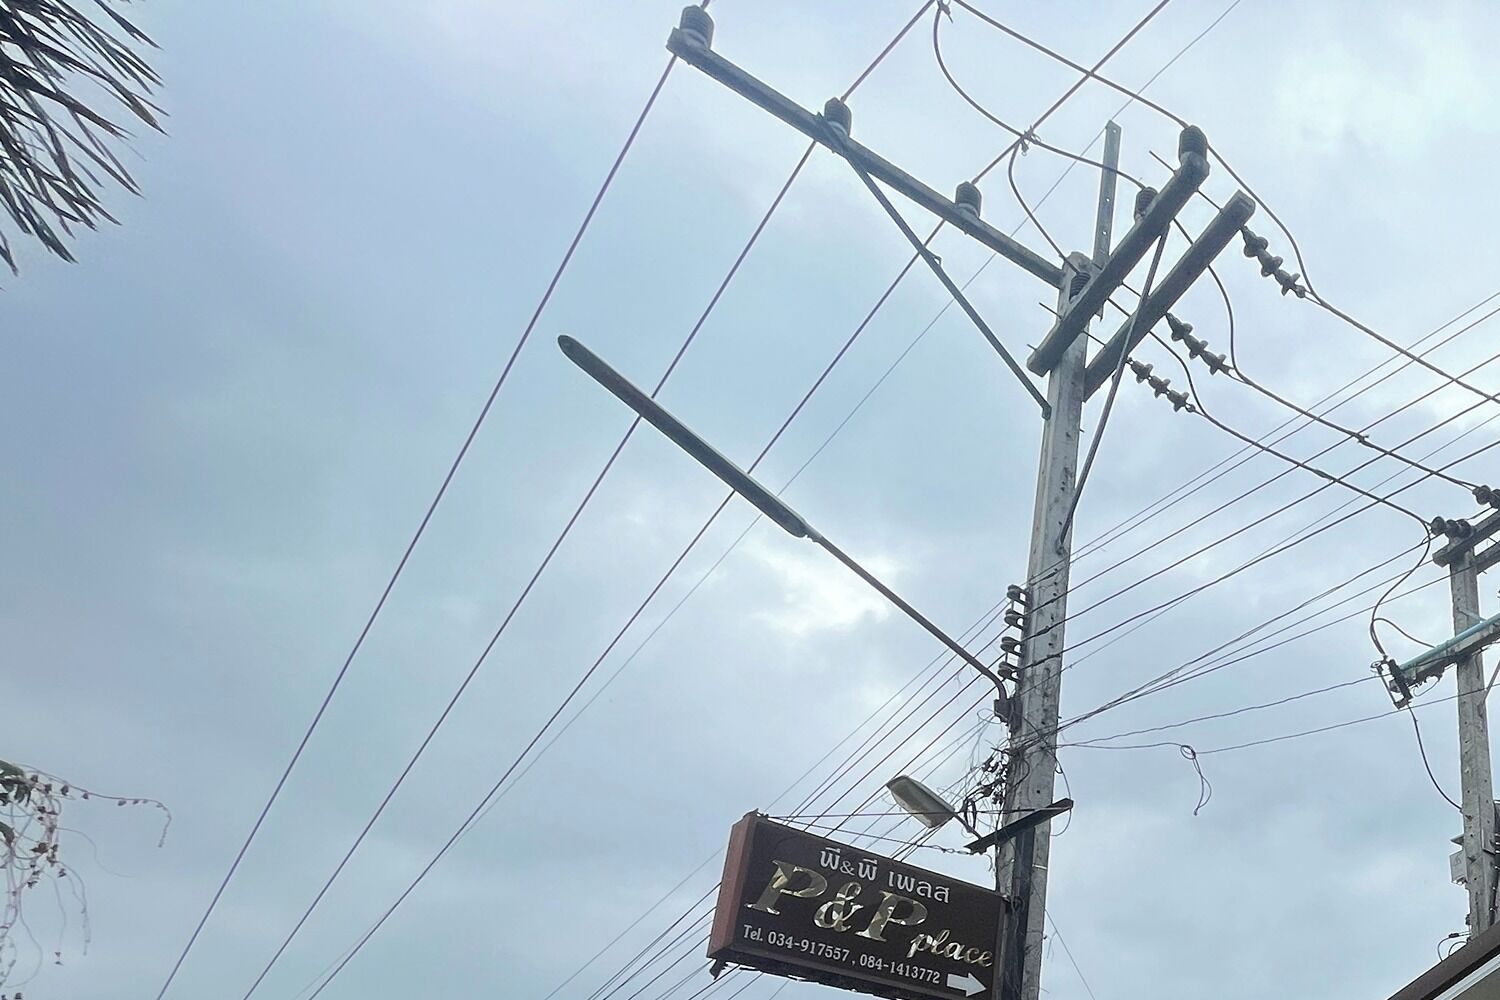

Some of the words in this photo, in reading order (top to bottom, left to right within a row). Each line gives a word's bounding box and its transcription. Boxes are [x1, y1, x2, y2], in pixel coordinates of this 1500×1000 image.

[744, 860, 928, 943] P&P
[906, 929, 994, 968] place
[888, 871, 950, 904] เพลส
[743, 924, 763, 942] Tel.
[859, 954, 941, 984] 084-1413772
